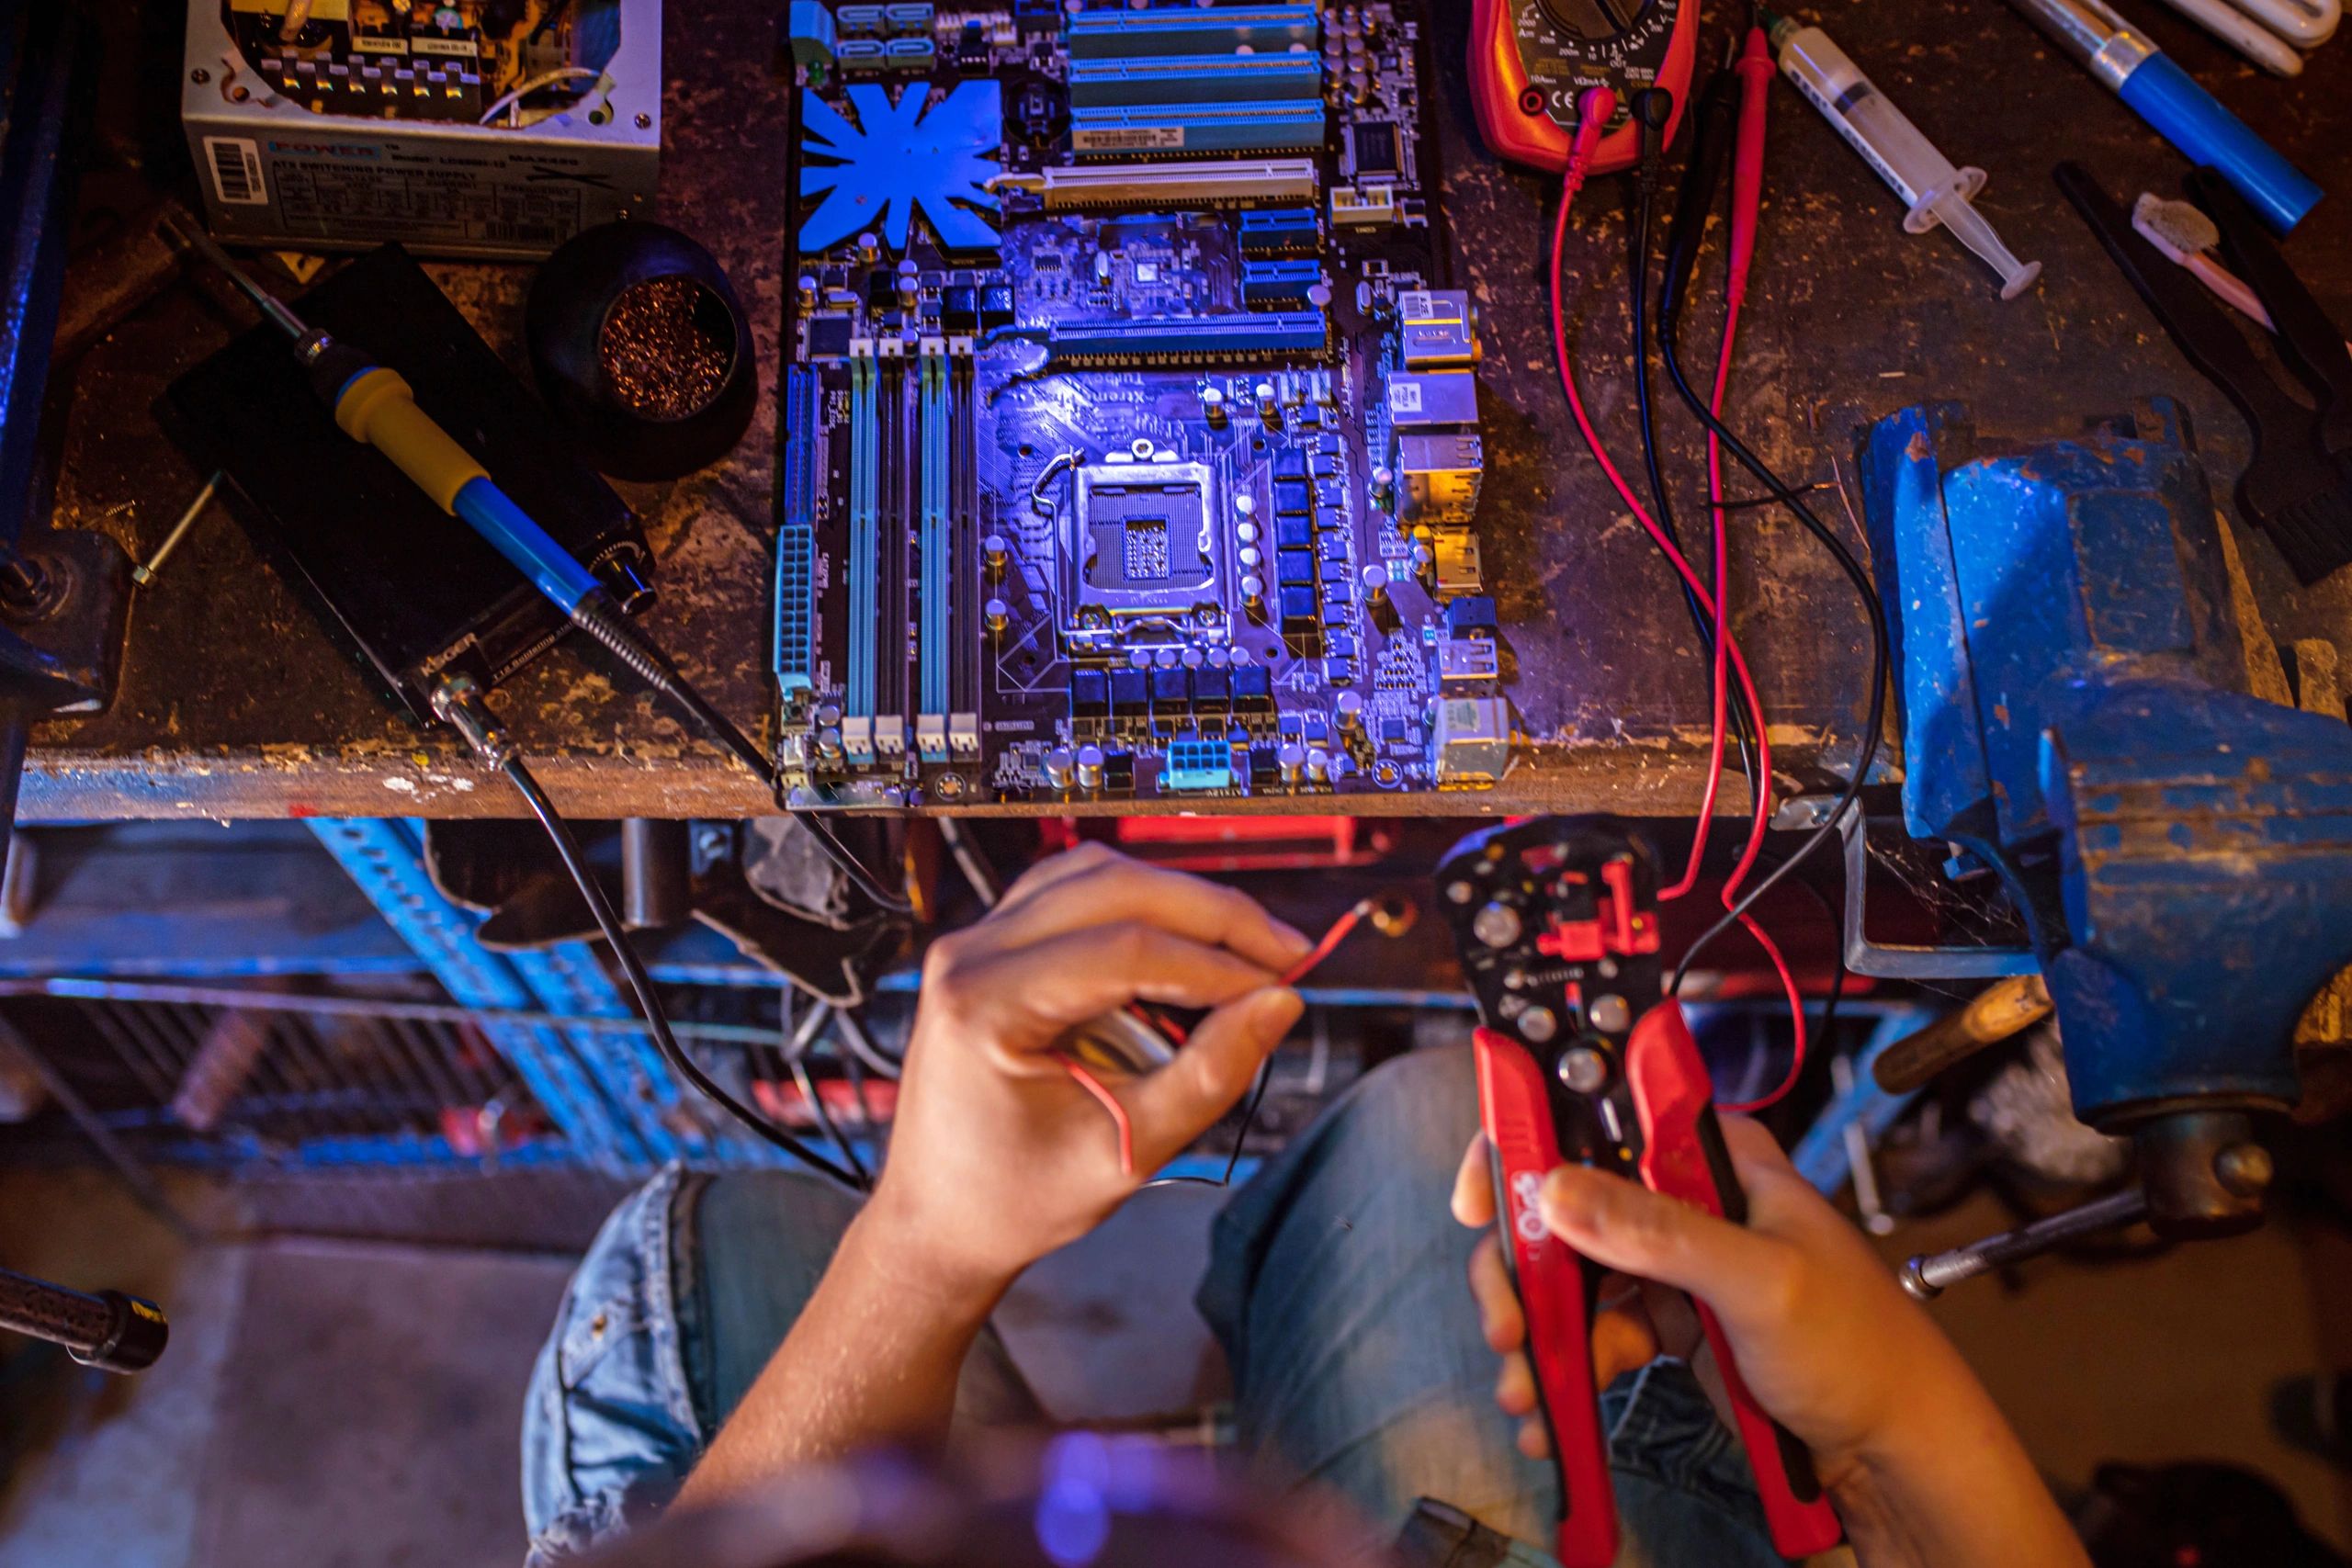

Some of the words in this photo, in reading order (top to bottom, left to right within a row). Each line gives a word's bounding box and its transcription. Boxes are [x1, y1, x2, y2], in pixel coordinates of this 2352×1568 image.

[1552, 90, 1574, 109] CE
[300, 161, 373, 175] SWITCHING
[377, 165, 424, 177] POWER
[427, 169, 477, 182] SUPPLY
